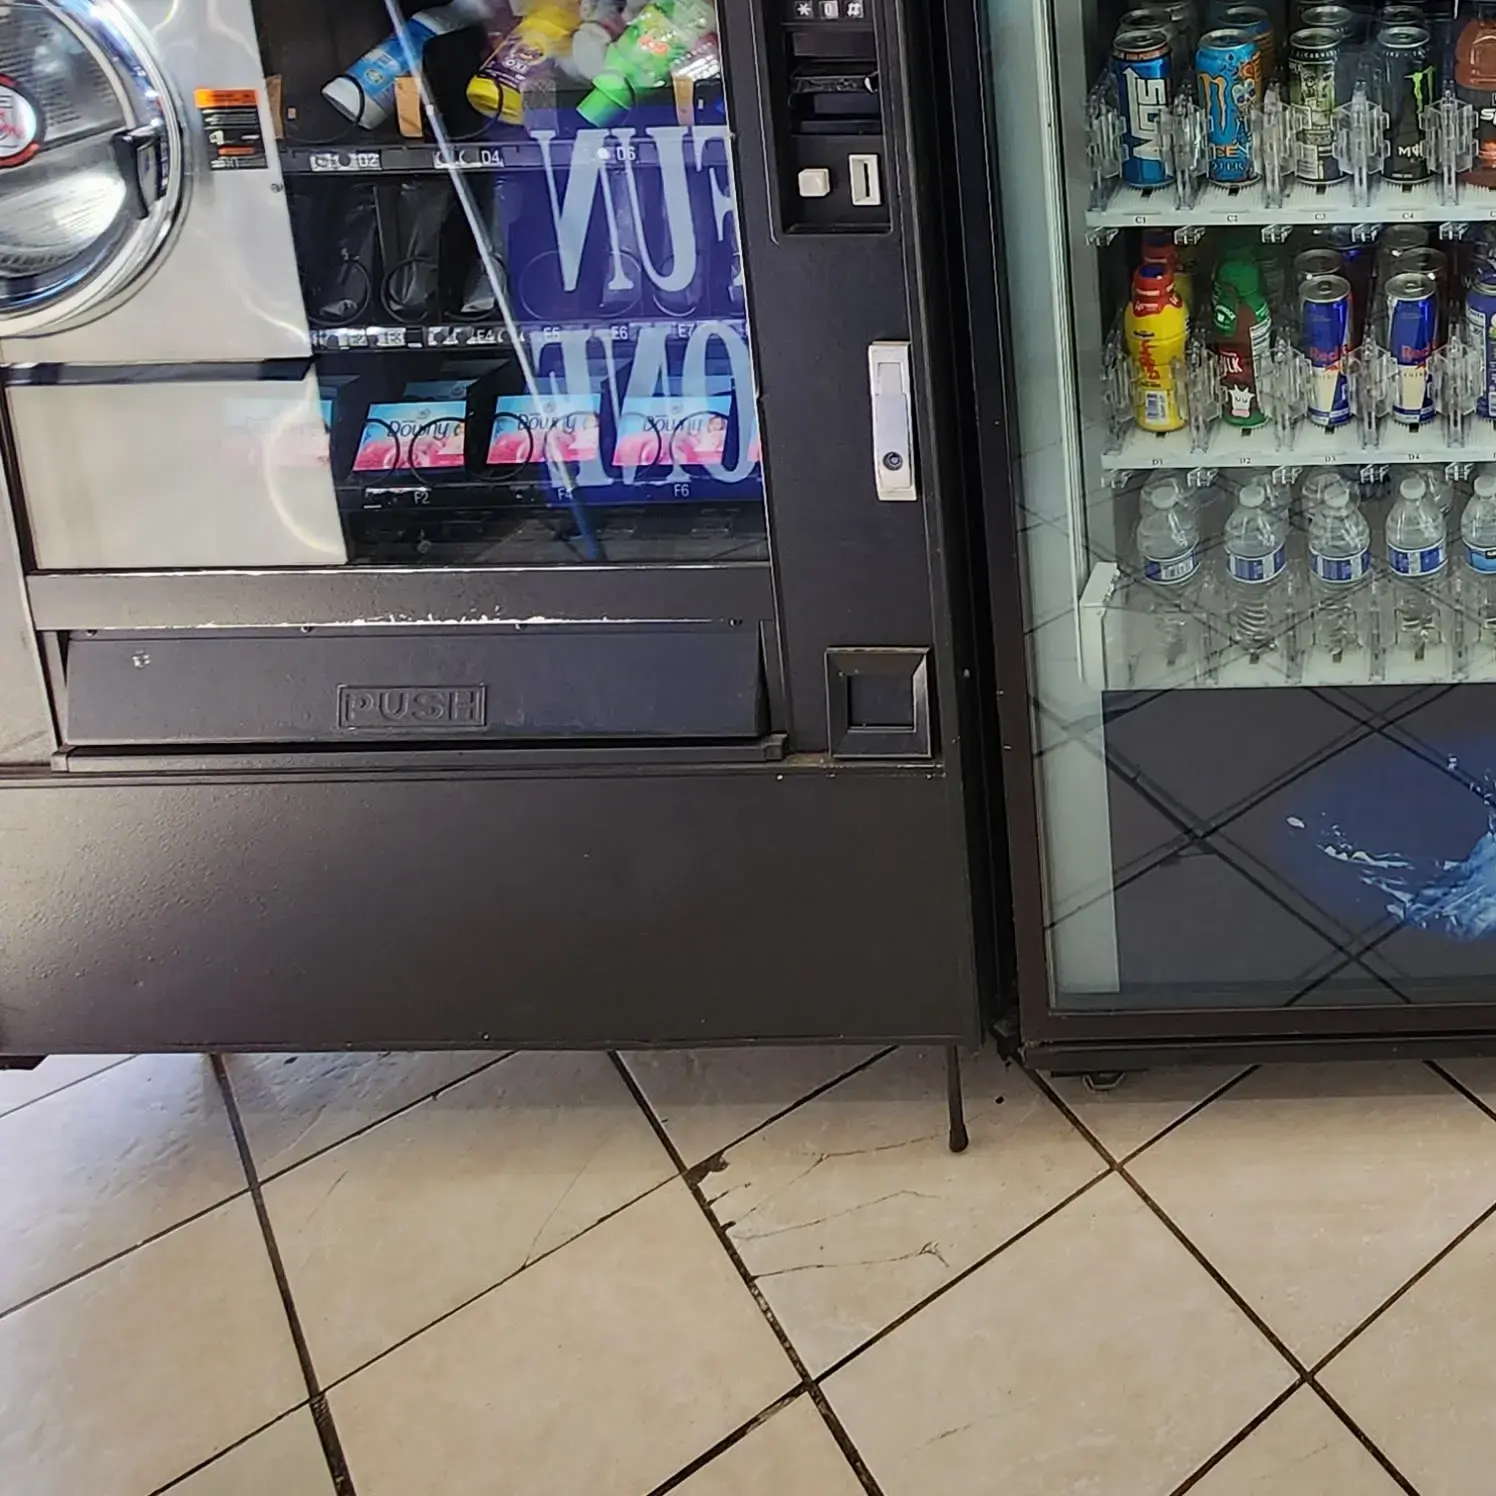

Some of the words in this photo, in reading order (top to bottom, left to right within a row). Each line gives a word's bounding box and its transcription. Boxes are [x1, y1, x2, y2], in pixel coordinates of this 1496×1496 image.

[504, 59, 528, 74] OXI
[481, 151, 500, 164] D4
[617, 147, 635, 160] D6
[359, 154, 377, 166] D2
[1135, 216, 1147, 224] C1
[1227, 214, 1239, 223] C2
[1315, 213, 1327, 221] C3
[1402, 211, 1414, 220] C4
[1310, 344, 1339, 360] Red
[387, 418, 447, 439] Downy
[1152, 458, 1164, 466] D1
[674, 484, 690, 497] F6
[414, 491, 430, 503] F2
[346, 691, 479, 721] PUSH
